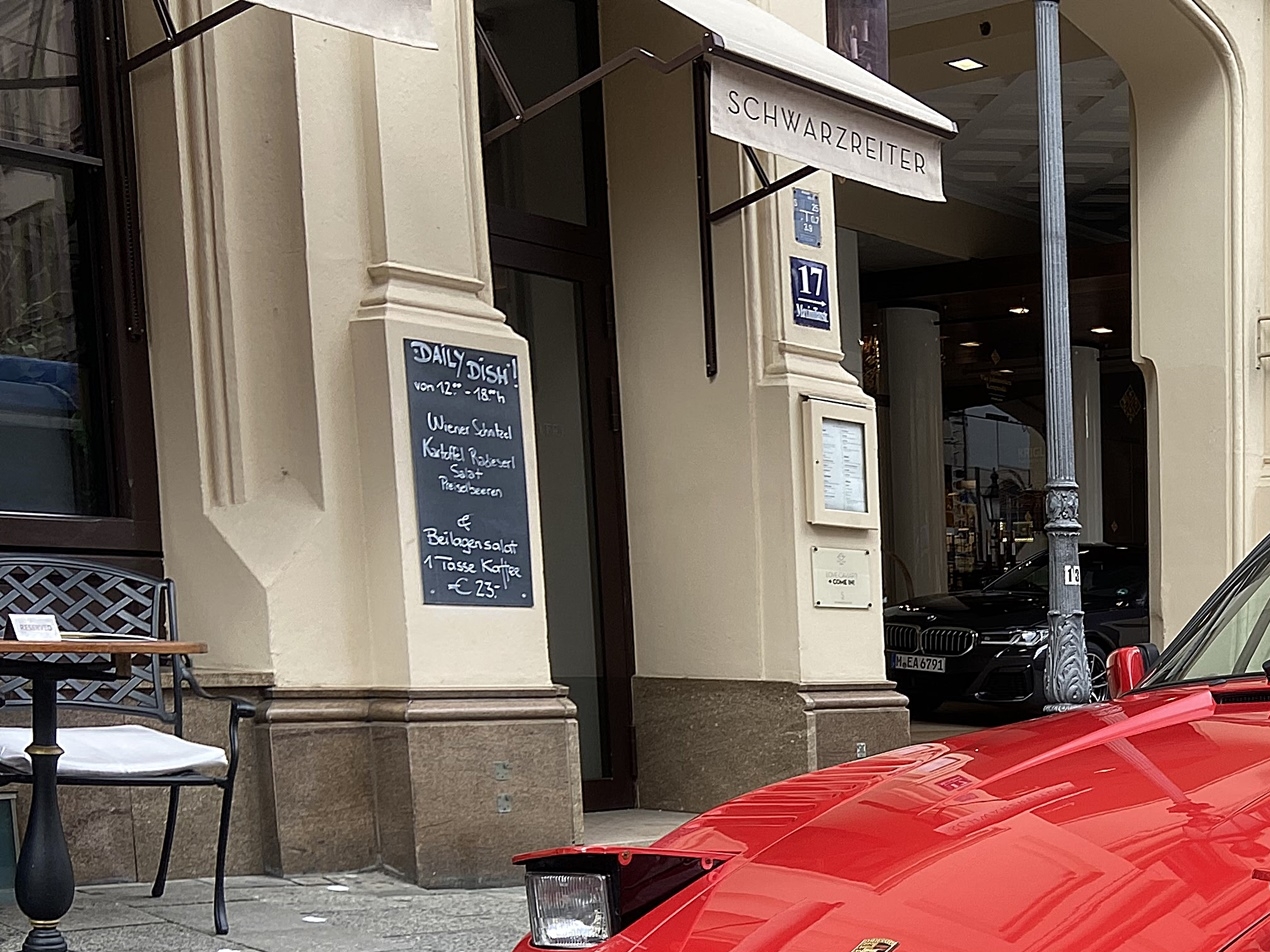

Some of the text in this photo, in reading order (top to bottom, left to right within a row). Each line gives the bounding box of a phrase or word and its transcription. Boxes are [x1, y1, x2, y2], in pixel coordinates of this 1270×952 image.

[728, 90, 926, 175] SCHWARZREITER
[798, 265, 822, 296] 17
[411, 340, 465, 378] DAILY
[414, 381, 434, 392] von
[427, 412, 513, 440] Wiener Schnitzel
[422, 436, 465, 462] Kartoffel
[449, 464, 484, 480] Salat
[438, 475, 503, 498] Preiselbeeren
[423, 555, 522, 590] 1 Tasse Kaffee
[833, 578, 847, 586] COME
[920, 659, 944, 671] 6791
